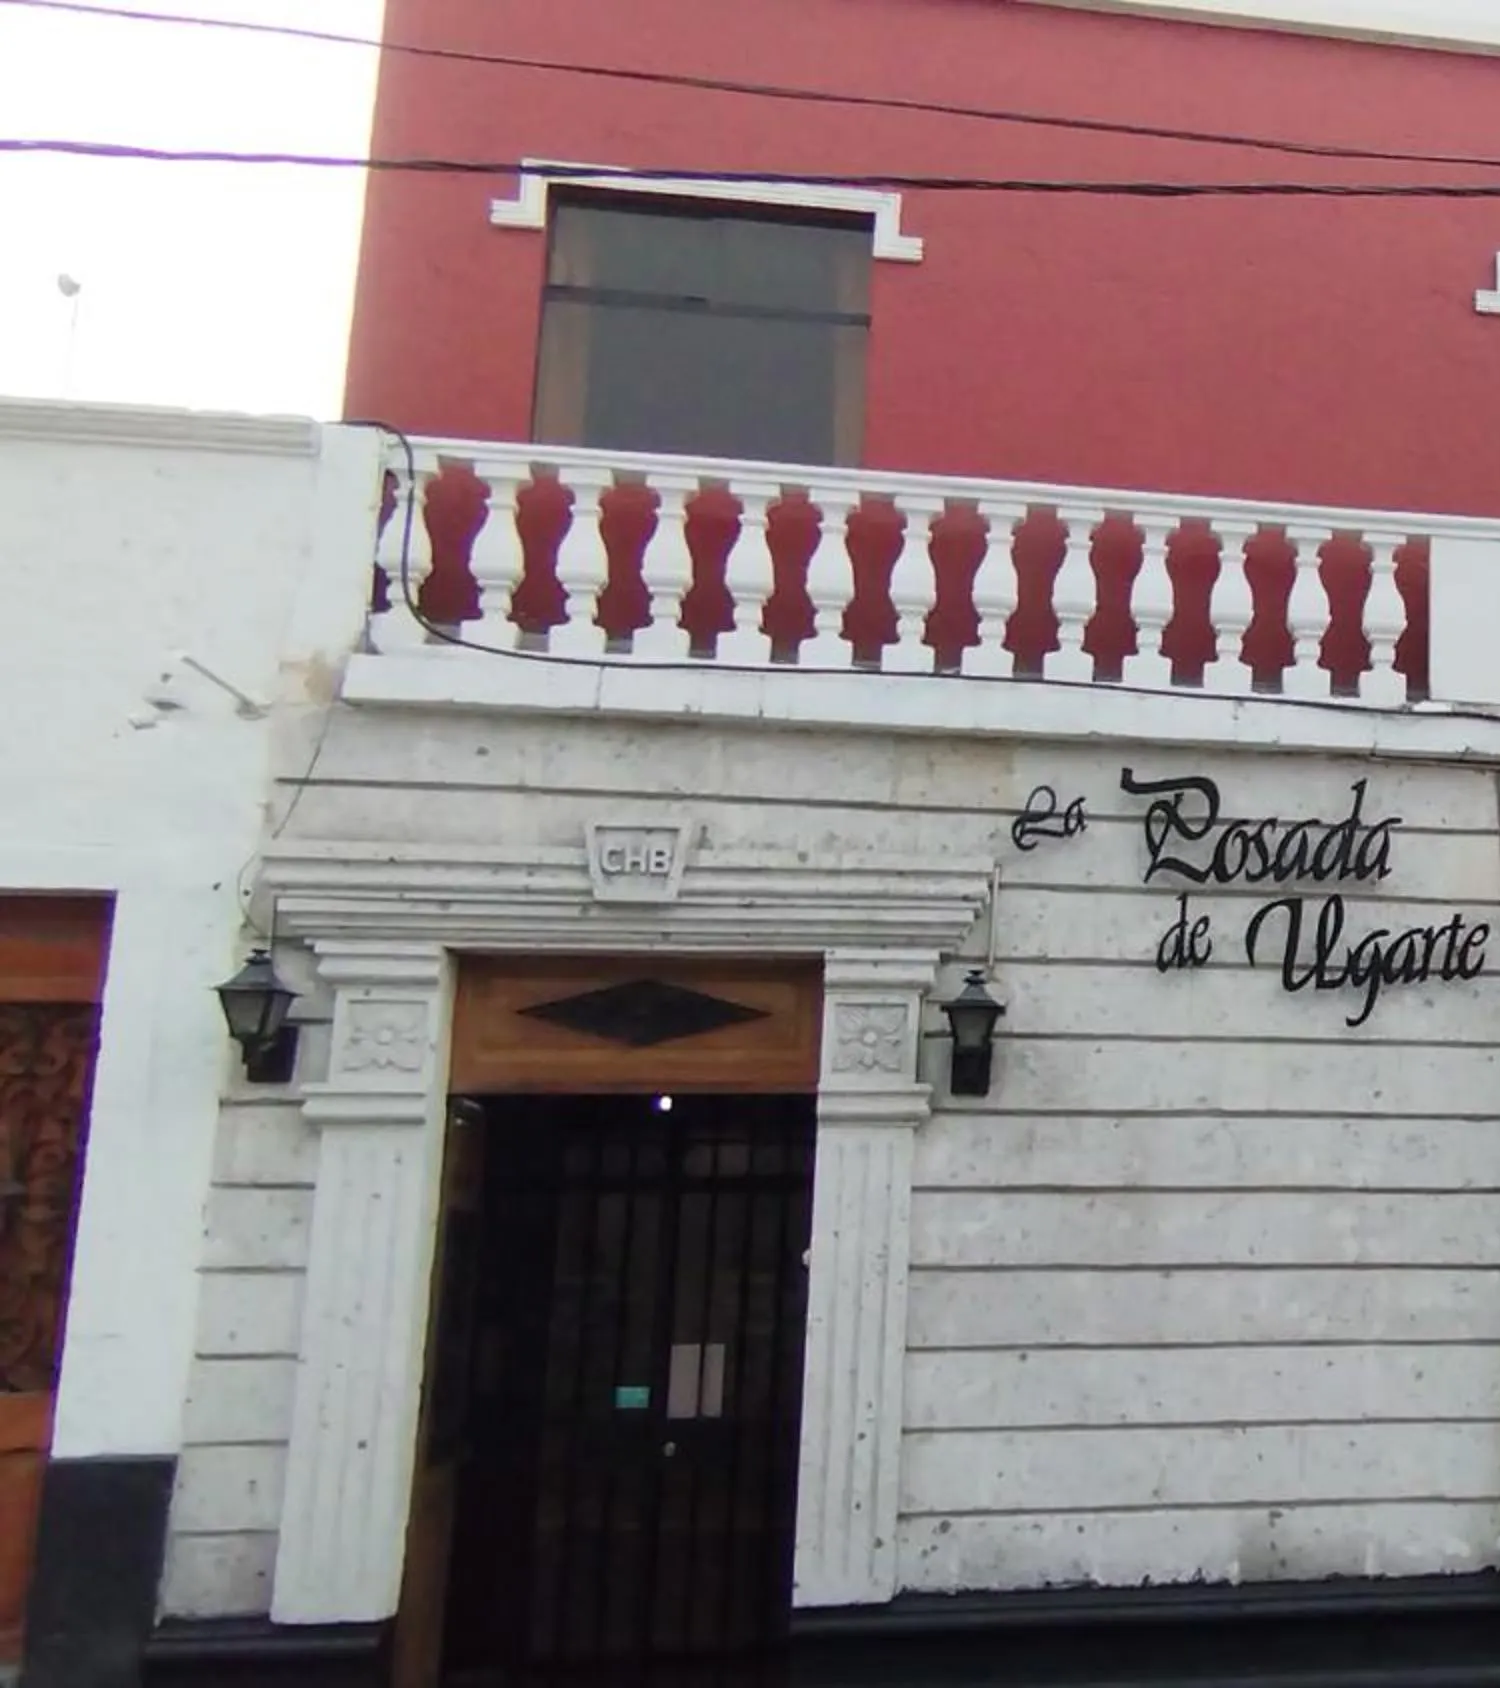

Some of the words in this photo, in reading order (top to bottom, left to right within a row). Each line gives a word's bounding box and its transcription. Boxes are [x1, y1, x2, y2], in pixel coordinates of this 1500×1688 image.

[601, 848, 671, 875] CHB
[1012, 785, 1087, 851] La
[1120, 767, 1402, 884] Posada
[1156, 893, 1212, 973] de
[1246, 894, 1491, 1028] Ugarte
